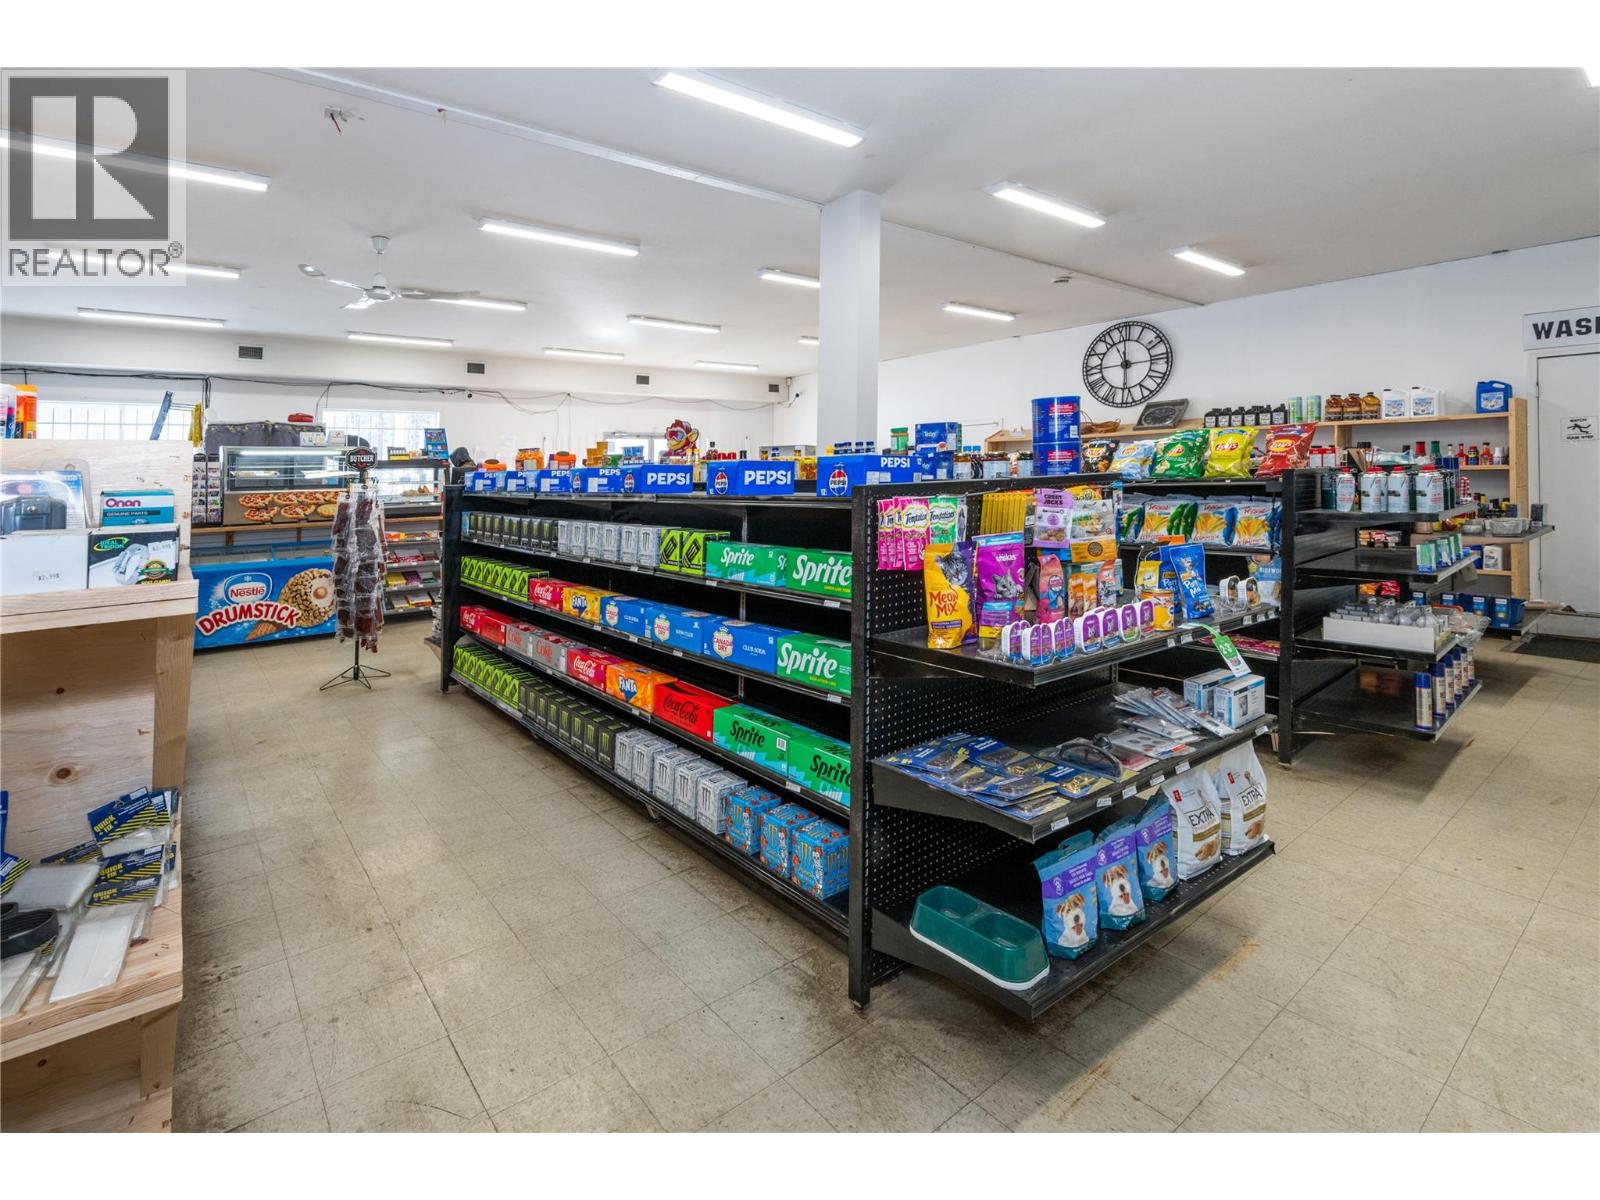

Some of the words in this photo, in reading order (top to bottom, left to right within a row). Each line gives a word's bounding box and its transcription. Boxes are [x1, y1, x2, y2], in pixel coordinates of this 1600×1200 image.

[1532, 316, 1600, 341] WAS
[350, 454, 374, 463] BUTCHER
[881, 458, 910, 468] PEPSI
[647, 472, 690, 485] PEPSI
[744, 470, 792, 486] PEPSI
[105, 498, 141, 508] Onan
[720, 547, 755, 567] Sprite
[792, 554, 852, 586] Sprite
[230, 586, 265, 598] Nestlé
[929, 591, 959, 607] Meow
[198, 602, 300, 634] DRUMSTICK
[777, 642, 838, 678] Sprite
[730, 720, 765, 748] Sprite
[1241, 788, 1263, 807] EXTRA
[1188, 806, 1215, 827] EXTRA
